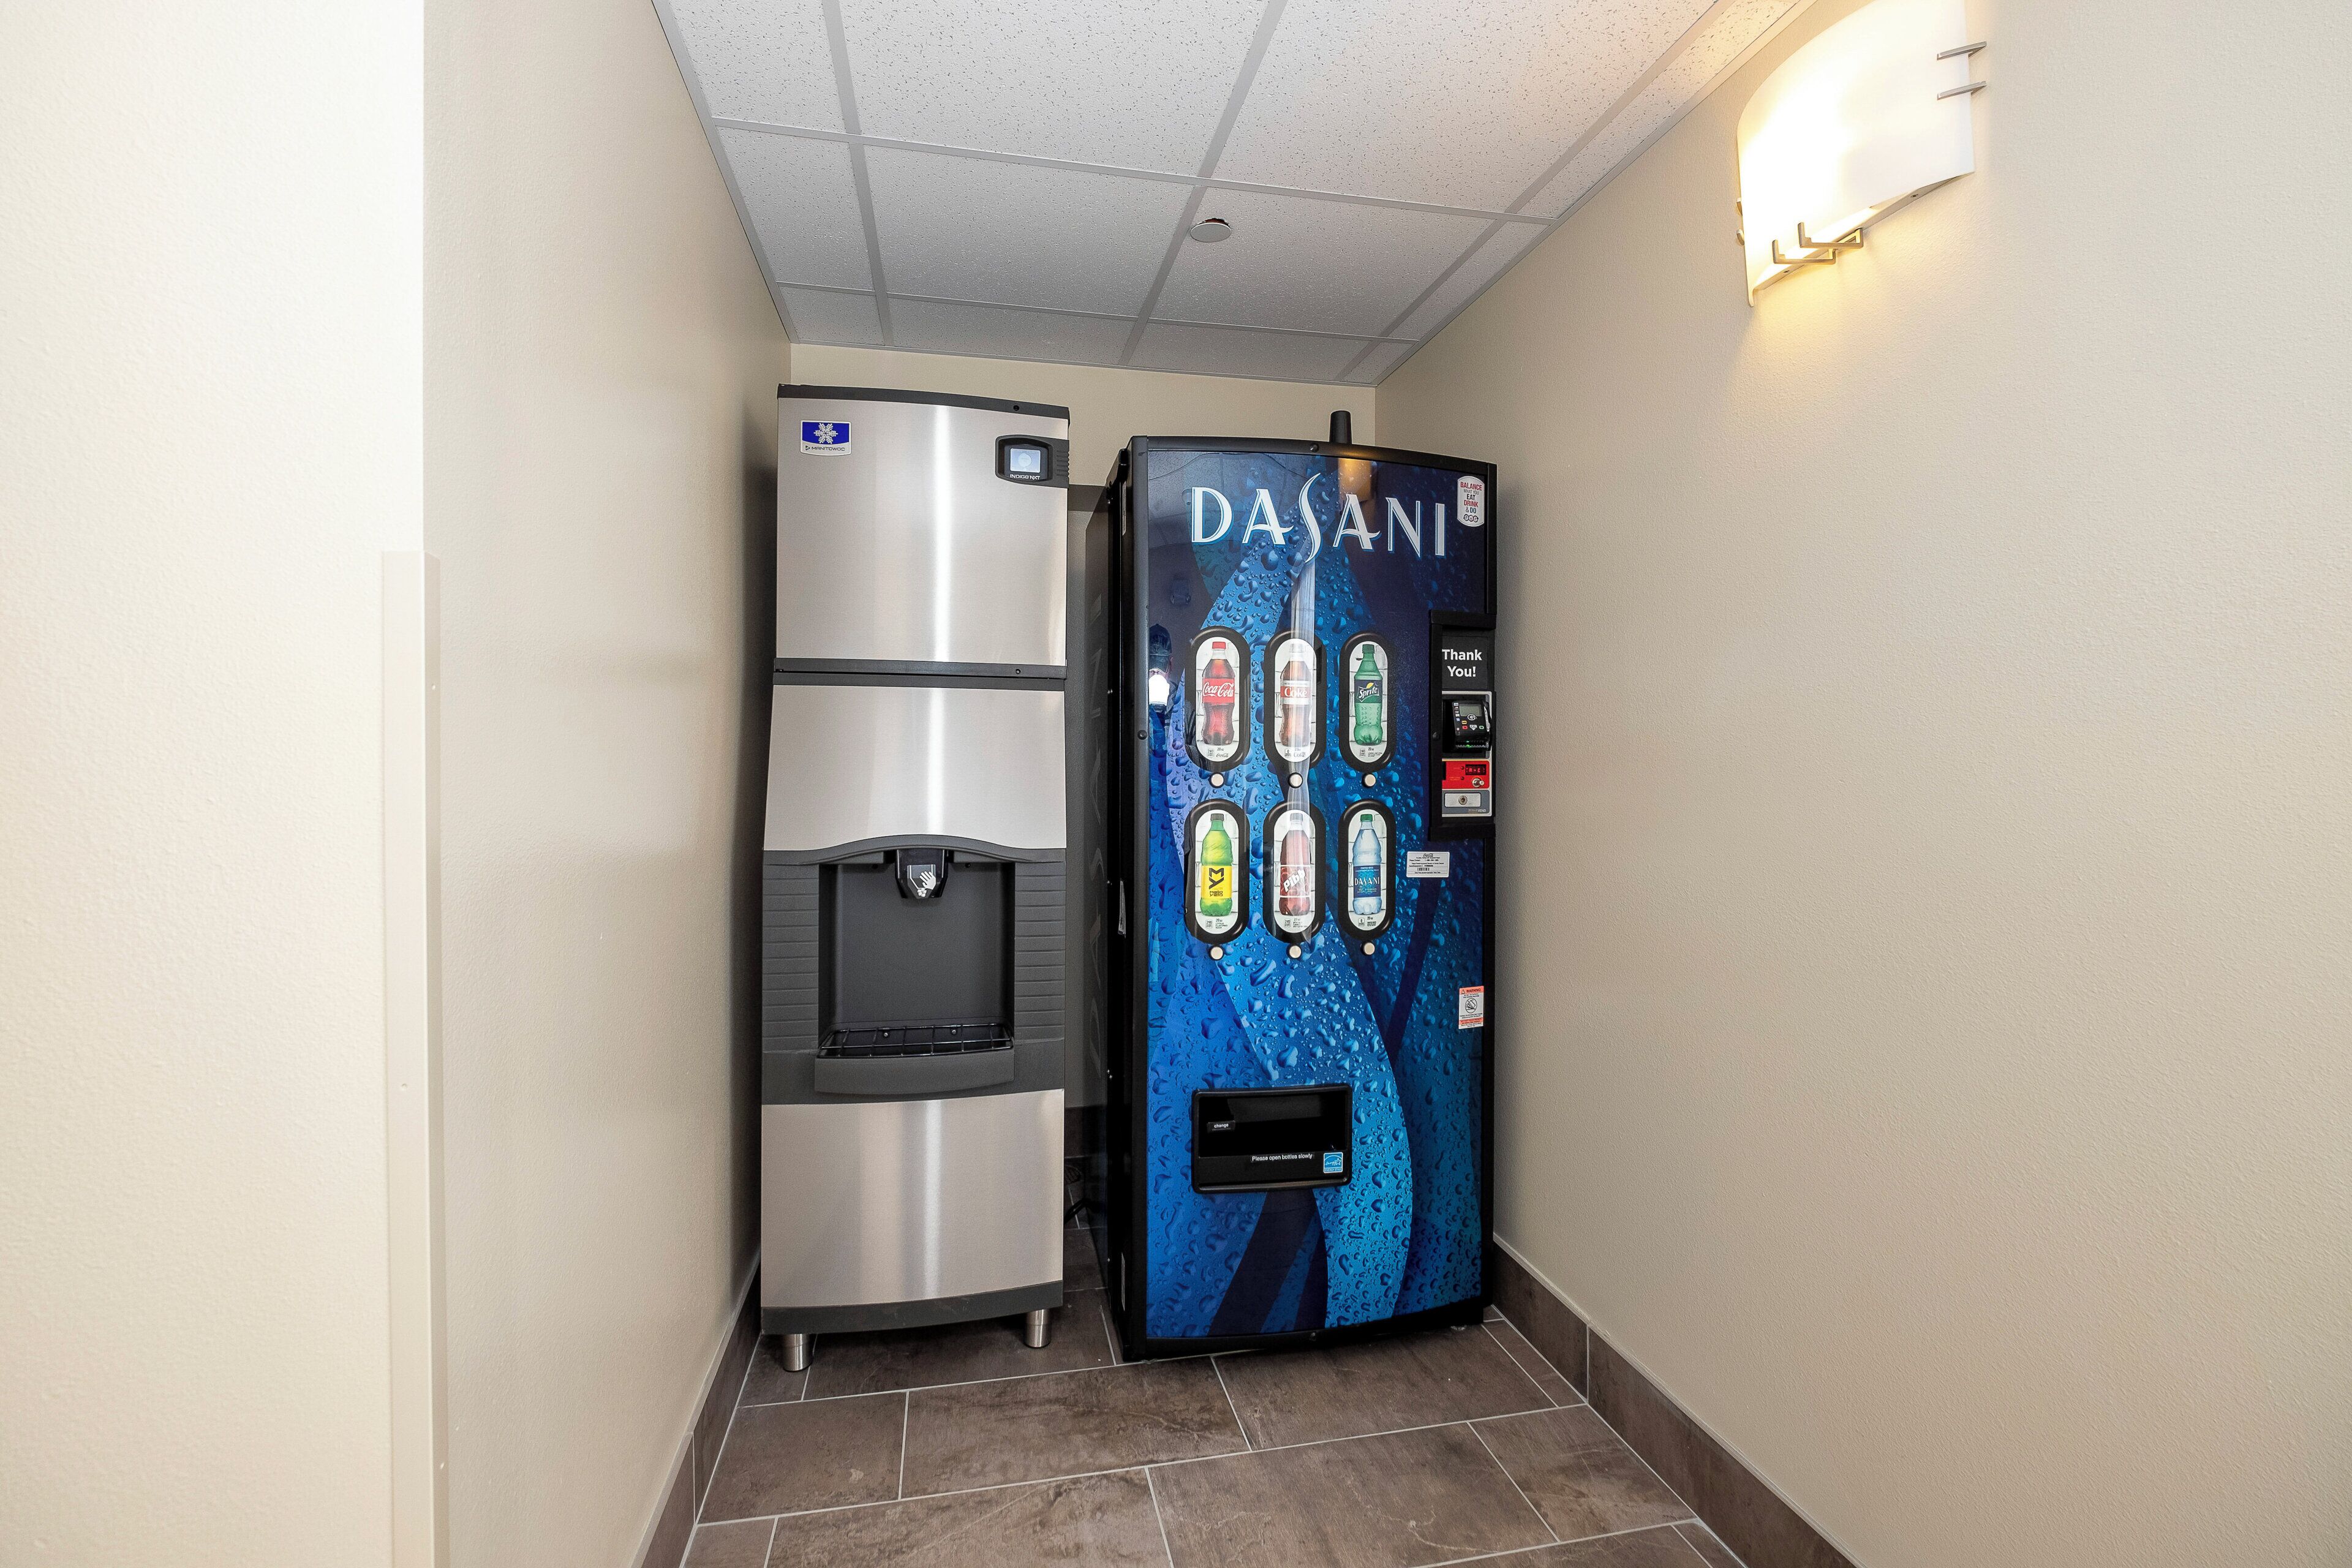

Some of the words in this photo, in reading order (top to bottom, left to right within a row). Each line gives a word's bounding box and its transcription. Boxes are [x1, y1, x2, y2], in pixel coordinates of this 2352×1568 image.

[1460, 481, 1482, 491] BALANCE
[1191, 472, 1447, 563] DASANI
[1442, 649, 1482, 661] Thank
[1447, 666, 1476, 677] You!
[1202, 682, 1234, 697] Coca-Cola
[1284, 687, 1308, 697] Coke
[1358, 685, 1378, 699] Sprite
[1354, 876, 1380, 886] DASANI
